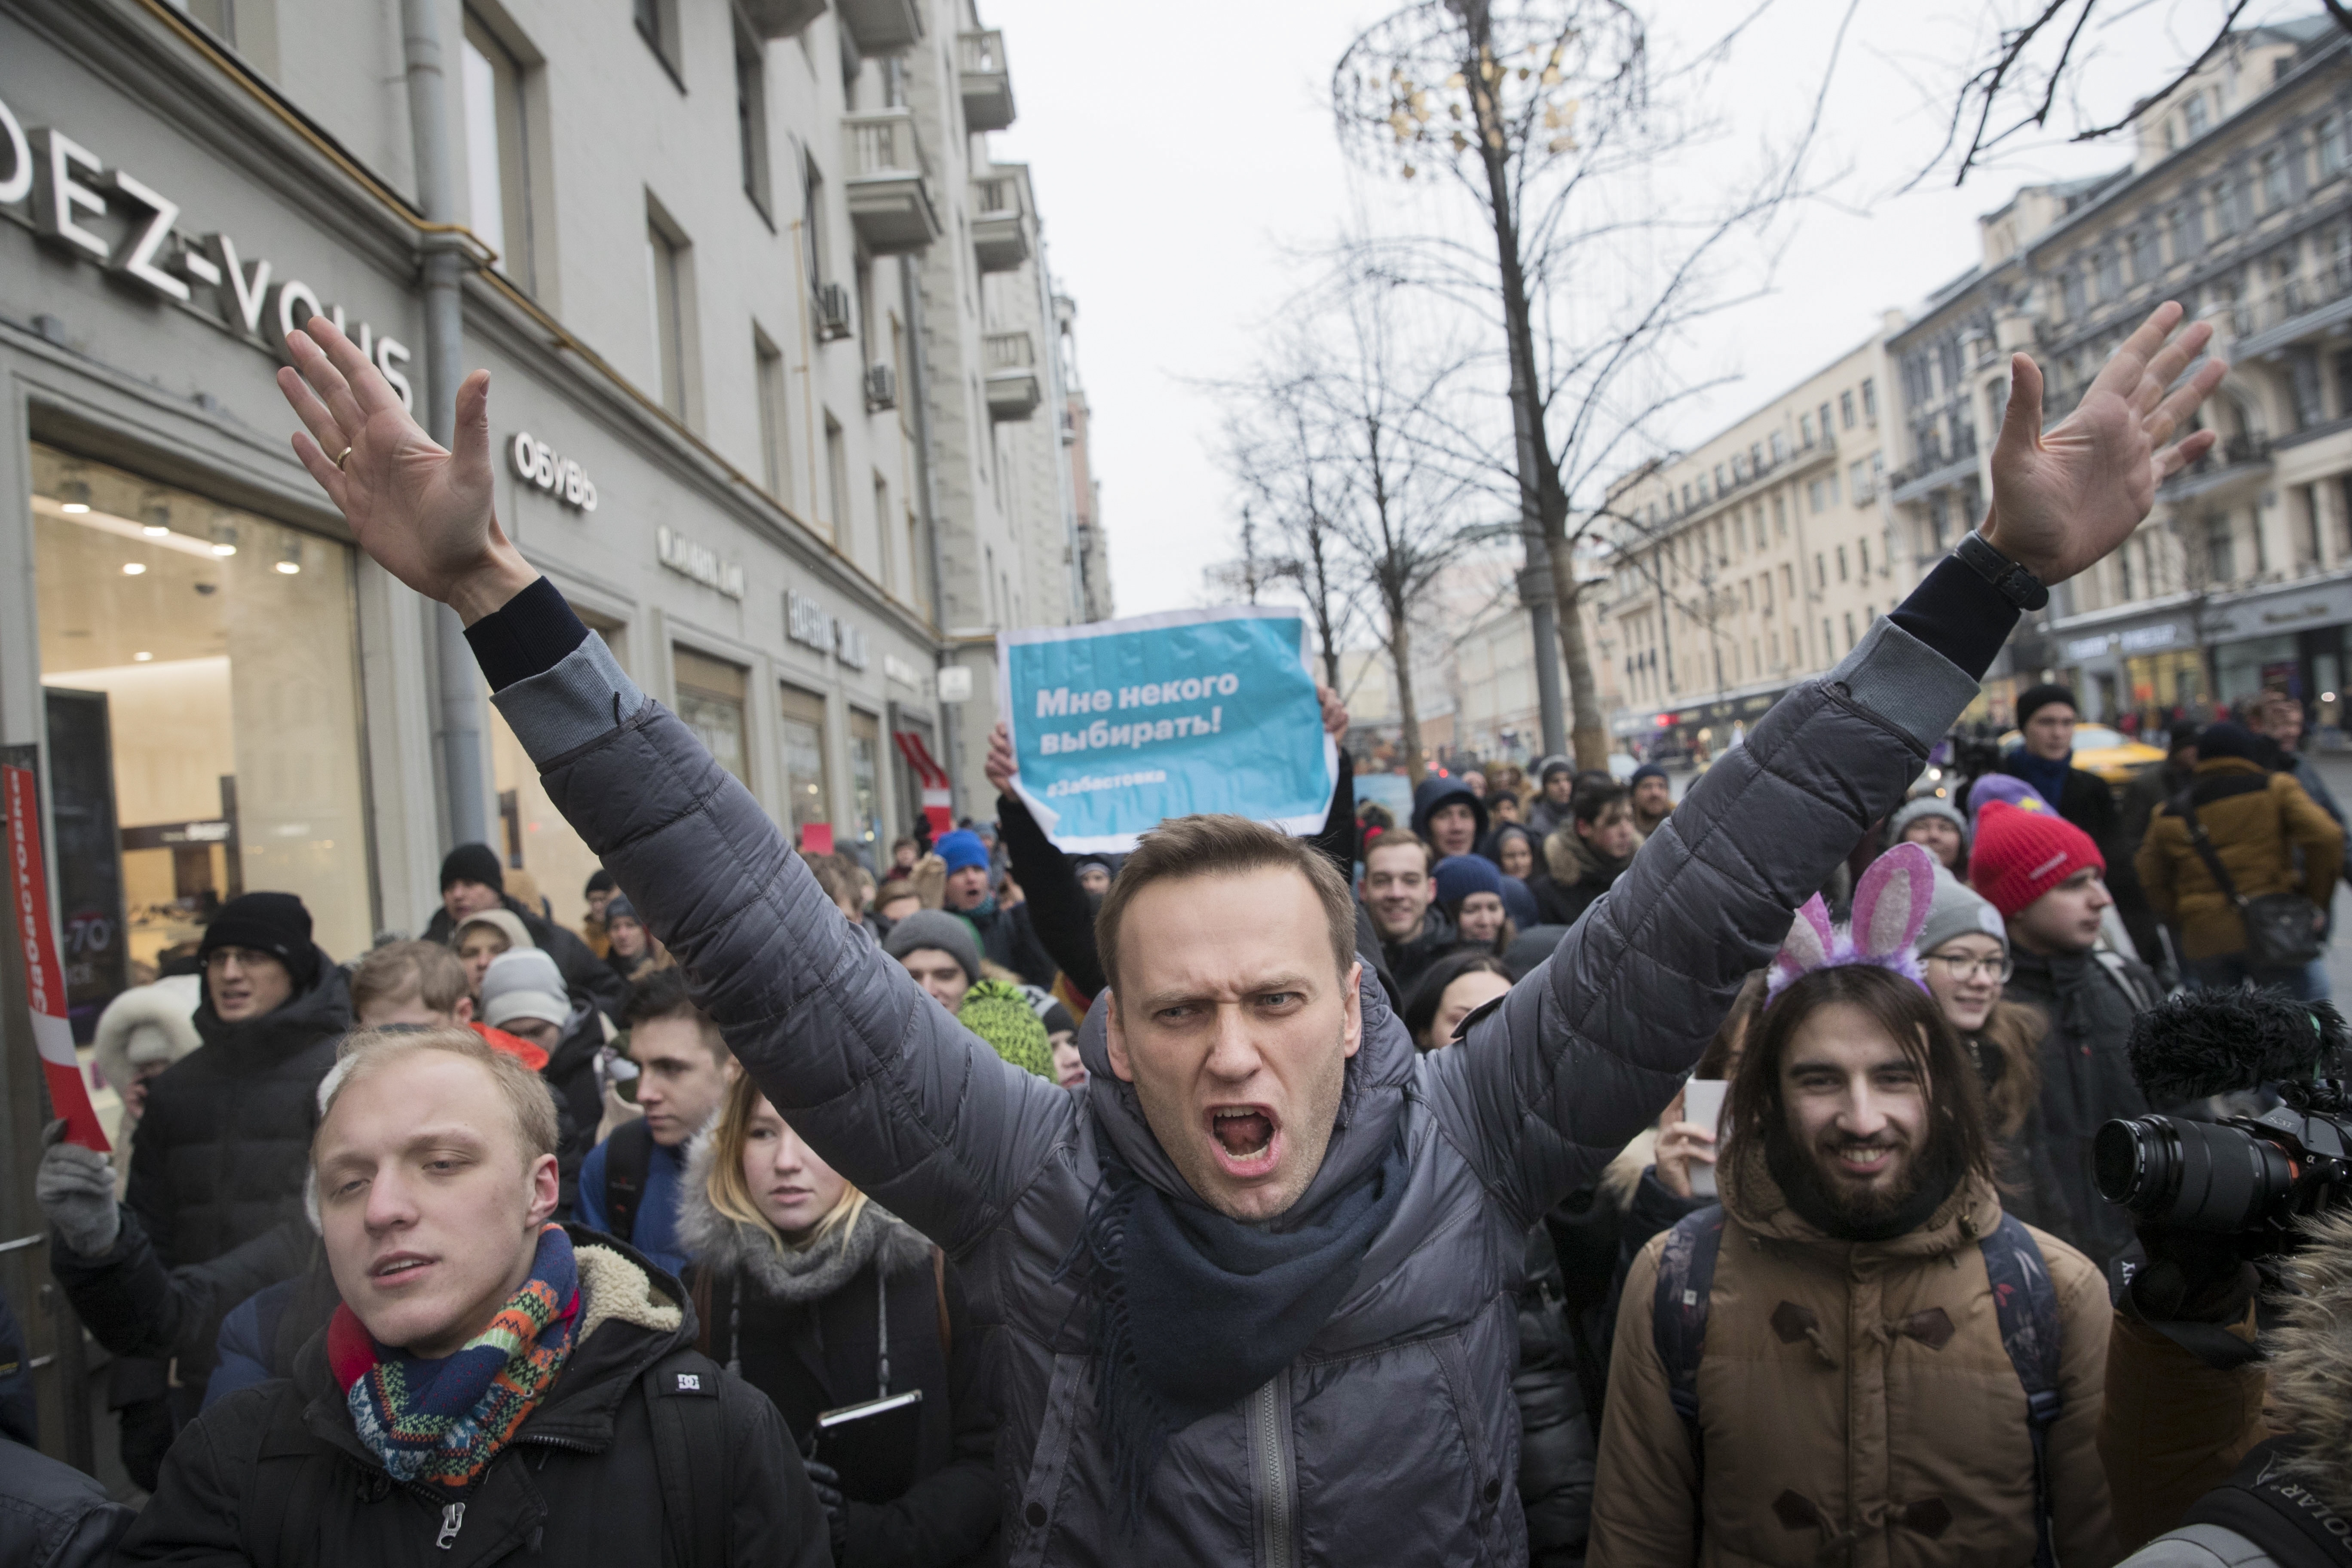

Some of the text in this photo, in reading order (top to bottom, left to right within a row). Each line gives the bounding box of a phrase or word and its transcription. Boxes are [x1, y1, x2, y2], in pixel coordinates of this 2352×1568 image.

[515, 431, 597, 512] ОБУВЬ
[1036, 673, 1239, 718] Мне некого
[1041, 706, 1222, 755] выбирать!
